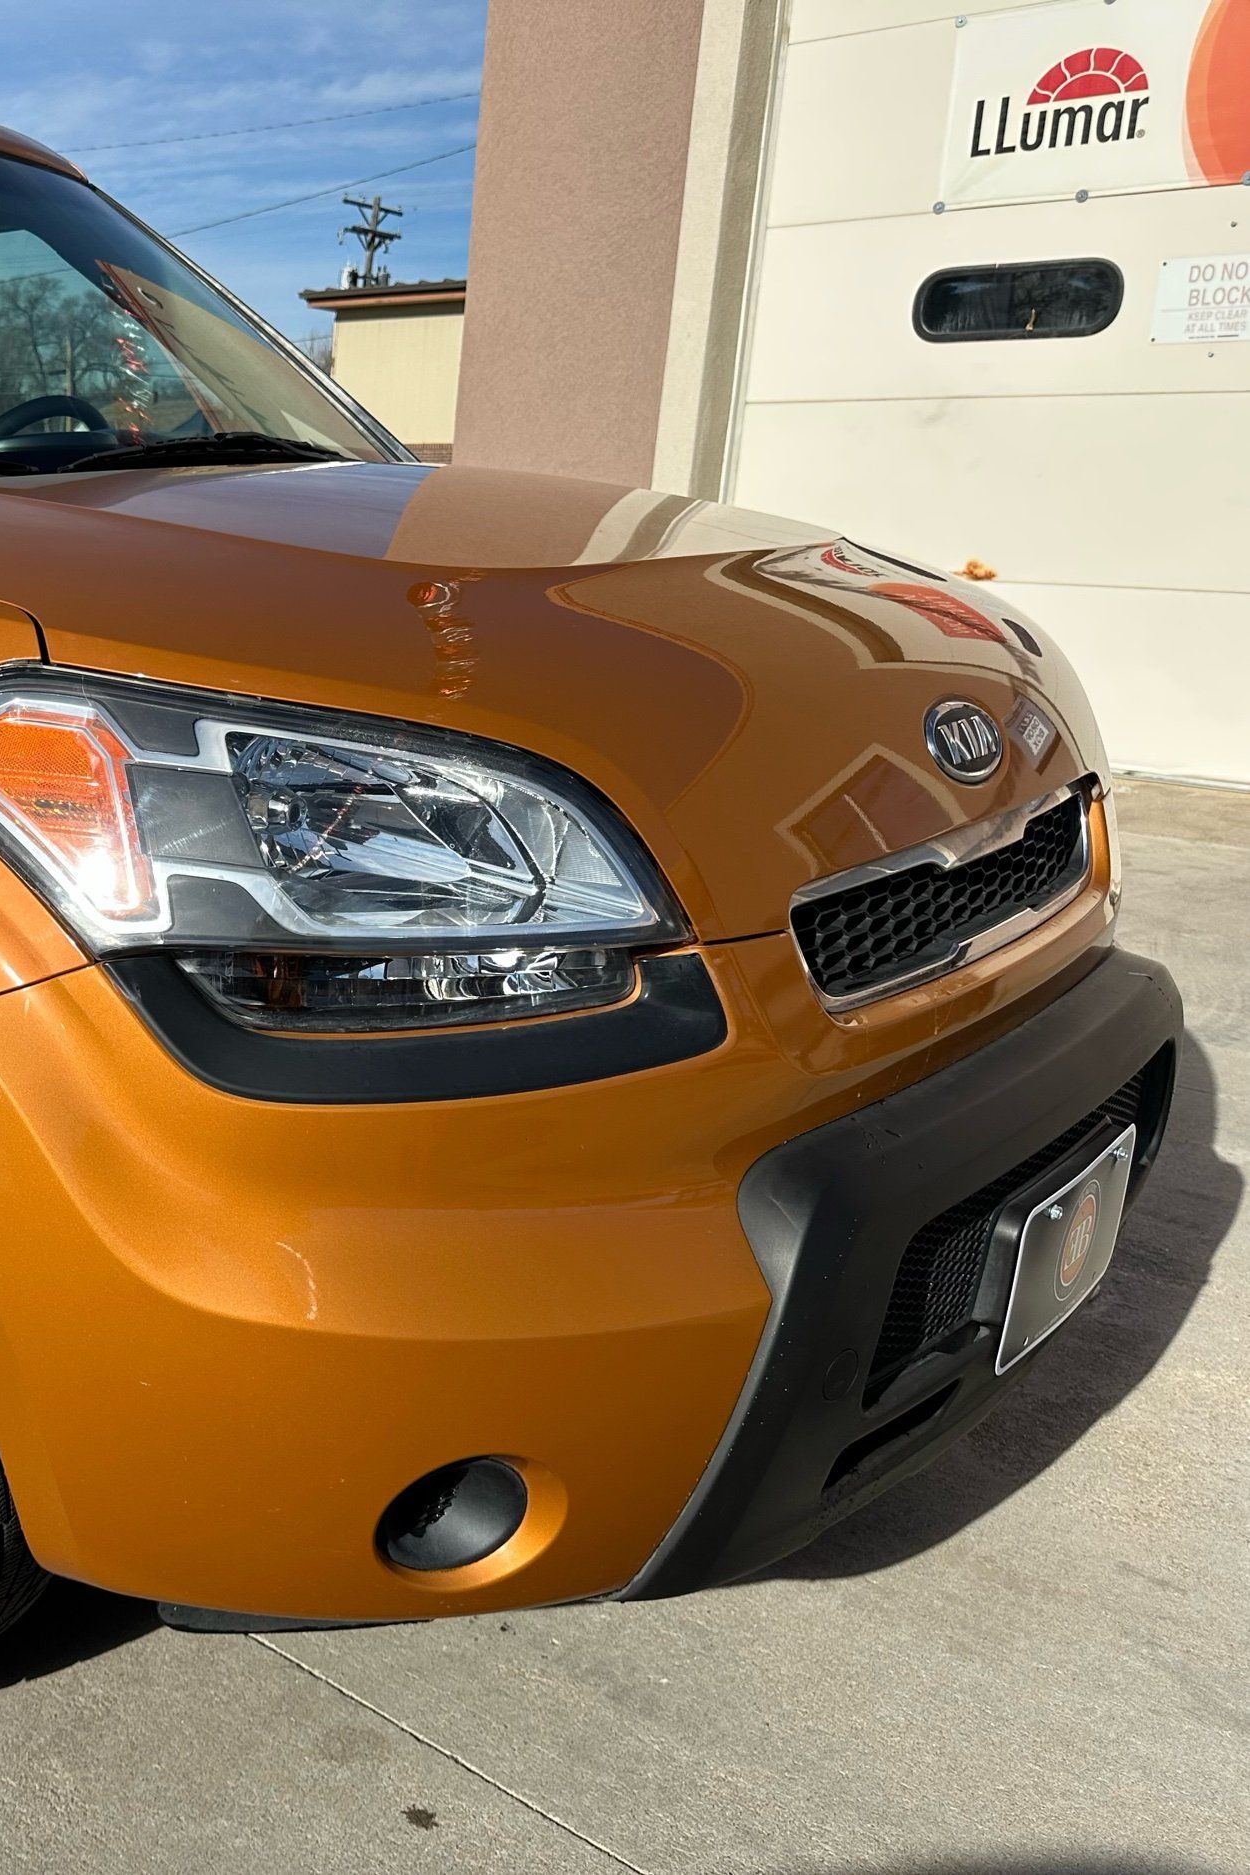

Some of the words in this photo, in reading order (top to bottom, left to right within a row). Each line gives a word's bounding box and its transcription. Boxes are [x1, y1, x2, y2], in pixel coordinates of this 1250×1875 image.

[1188, 264, 1215, 283] DO
[1221, 261, 1250, 281] NO
[1188, 286, 1250, 306] BLOCK
[1188, 311, 1213, 321] KEEP
[1215, 309, 1247, 320] CLEAR
[1184, 323, 1196, 333] AT
[1198, 323, 1215, 333] ALL
[1218, 321, 1246, 332] TIMES
[938, 715, 996, 765] KIA
